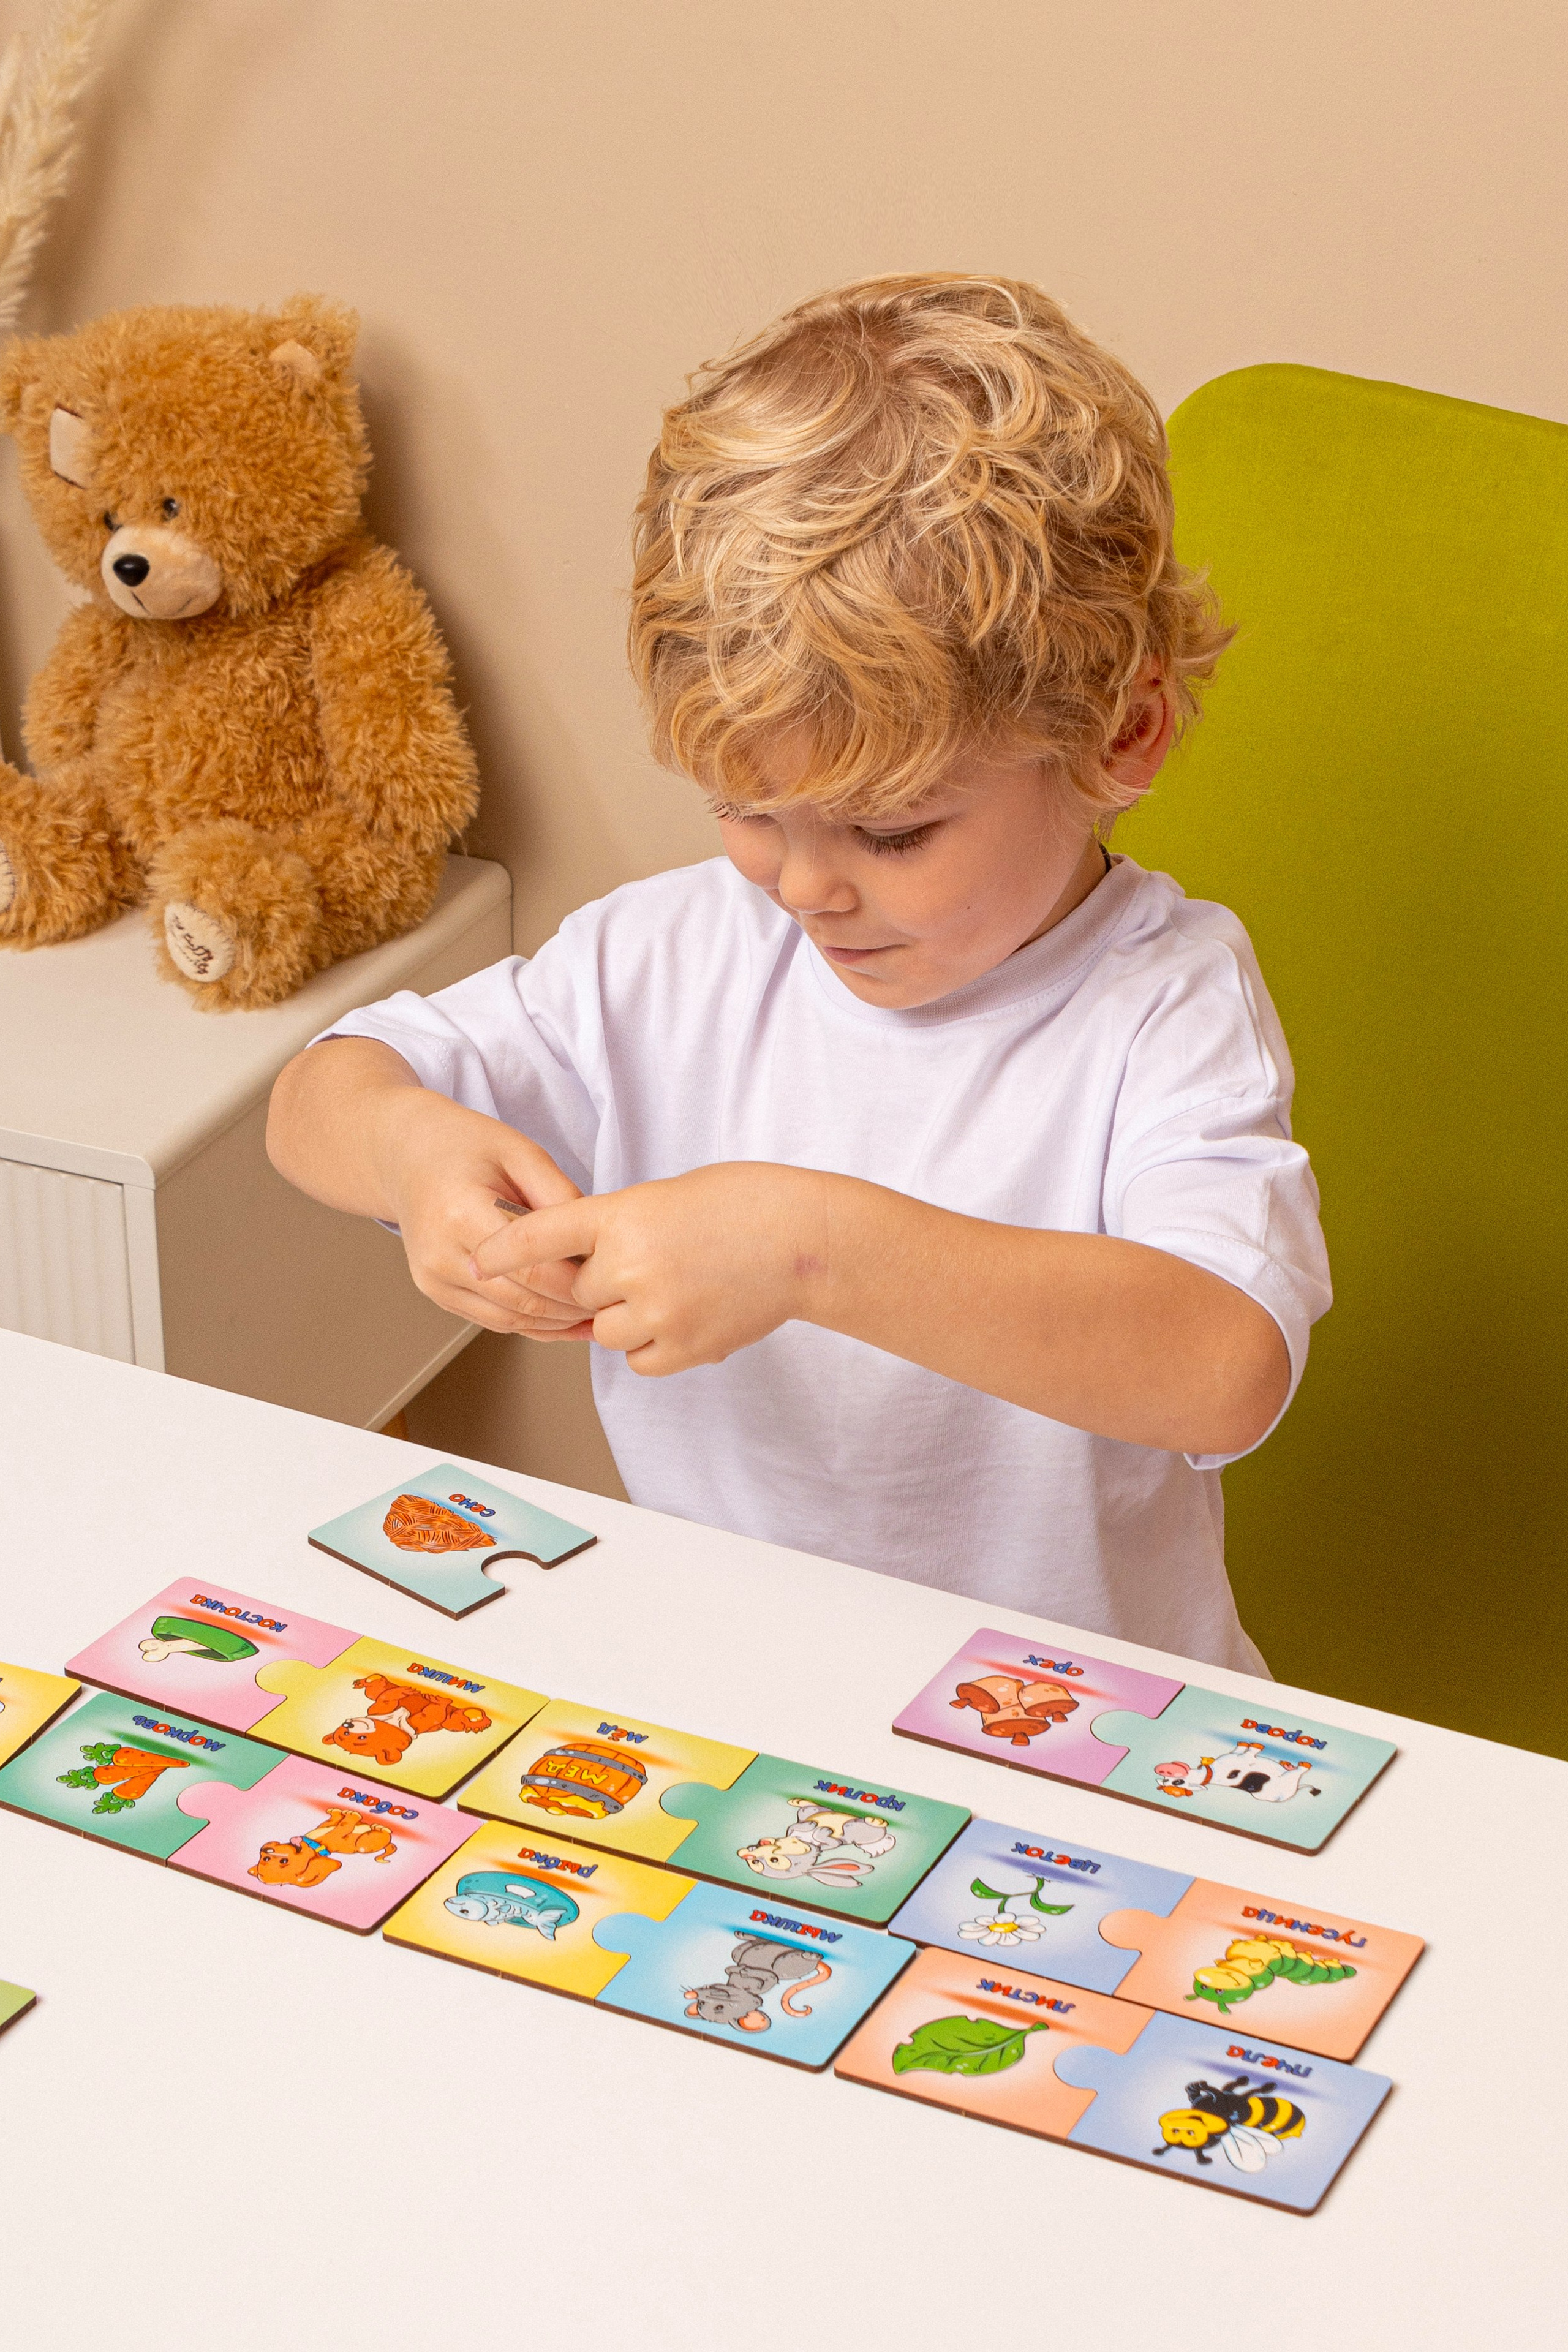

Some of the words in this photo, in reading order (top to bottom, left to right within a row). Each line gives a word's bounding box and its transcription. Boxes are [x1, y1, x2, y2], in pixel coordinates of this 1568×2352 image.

[448, 1493, 496, 1517] сено
[190, 1594, 288, 1634] косточка
[407, 1662, 486, 1693] мишка
[1023, 1654, 1084, 1676] орех
[132, 1715, 225, 1753] морковь
[597, 1722, 648, 1744] мёд
[1240, 1719, 1327, 1750] корова
[546, 1761, 607, 1785] МЕД
[337, 1787, 419, 1821] собака
[813, 1779, 906, 1811] кролик
[518, 1847, 598, 1878] рыбка
[1011, 1841, 1101, 1874] цветок
[750, 1910, 842, 1944] мышка
[1242, 1905, 1367, 1948] гусеница
[976, 1978, 1076, 2014] листик
[1227, 2045, 1312, 2078] пчела
